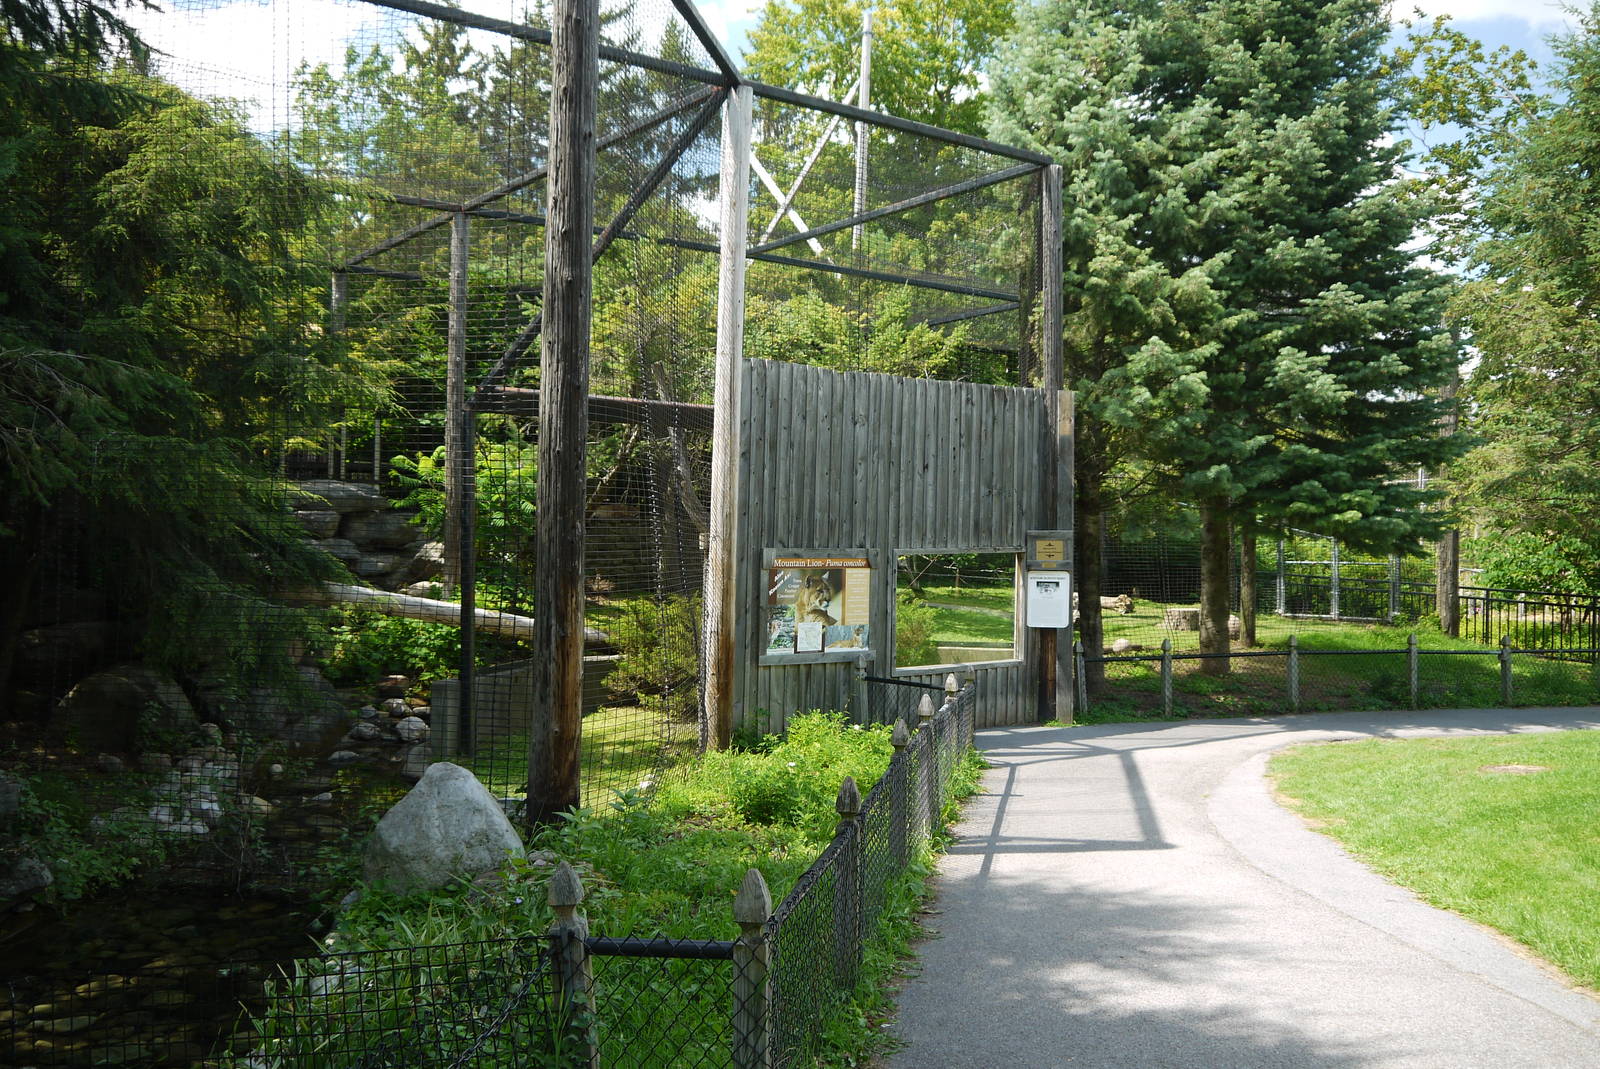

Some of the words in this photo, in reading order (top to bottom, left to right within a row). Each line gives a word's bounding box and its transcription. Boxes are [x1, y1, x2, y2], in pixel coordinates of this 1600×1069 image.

[774, 559, 806, 567] Mountain
[825, 559, 842, 567] Puma
[843, 559, 866, 567] concolor
